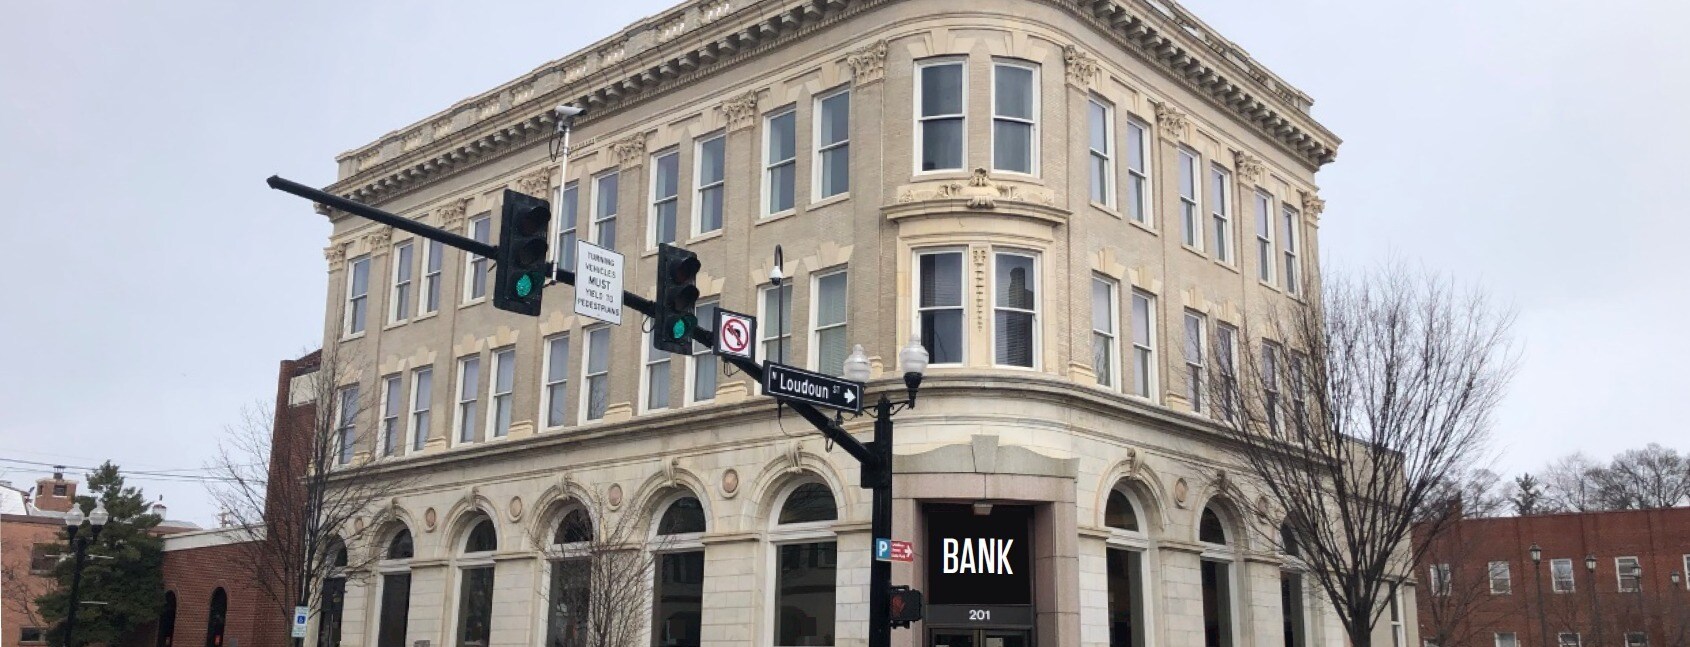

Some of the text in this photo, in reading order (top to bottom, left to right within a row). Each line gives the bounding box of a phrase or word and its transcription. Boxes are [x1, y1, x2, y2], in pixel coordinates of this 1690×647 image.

[588, 252, 614, 266] TURNING
[585, 262, 616, 278] VEHICLES
[589, 275, 611, 290] MUST
[586, 288, 613, 303] YIELD TO
[578, 299, 619, 316] PEDESTRIANS
[780, 372, 829, 399] Loudoun
[832, 385, 840, 394] ST
[878, 540, 888, 557] P
[943, 537, 1014, 575] BANK
[968, 609, 991, 621] 201
